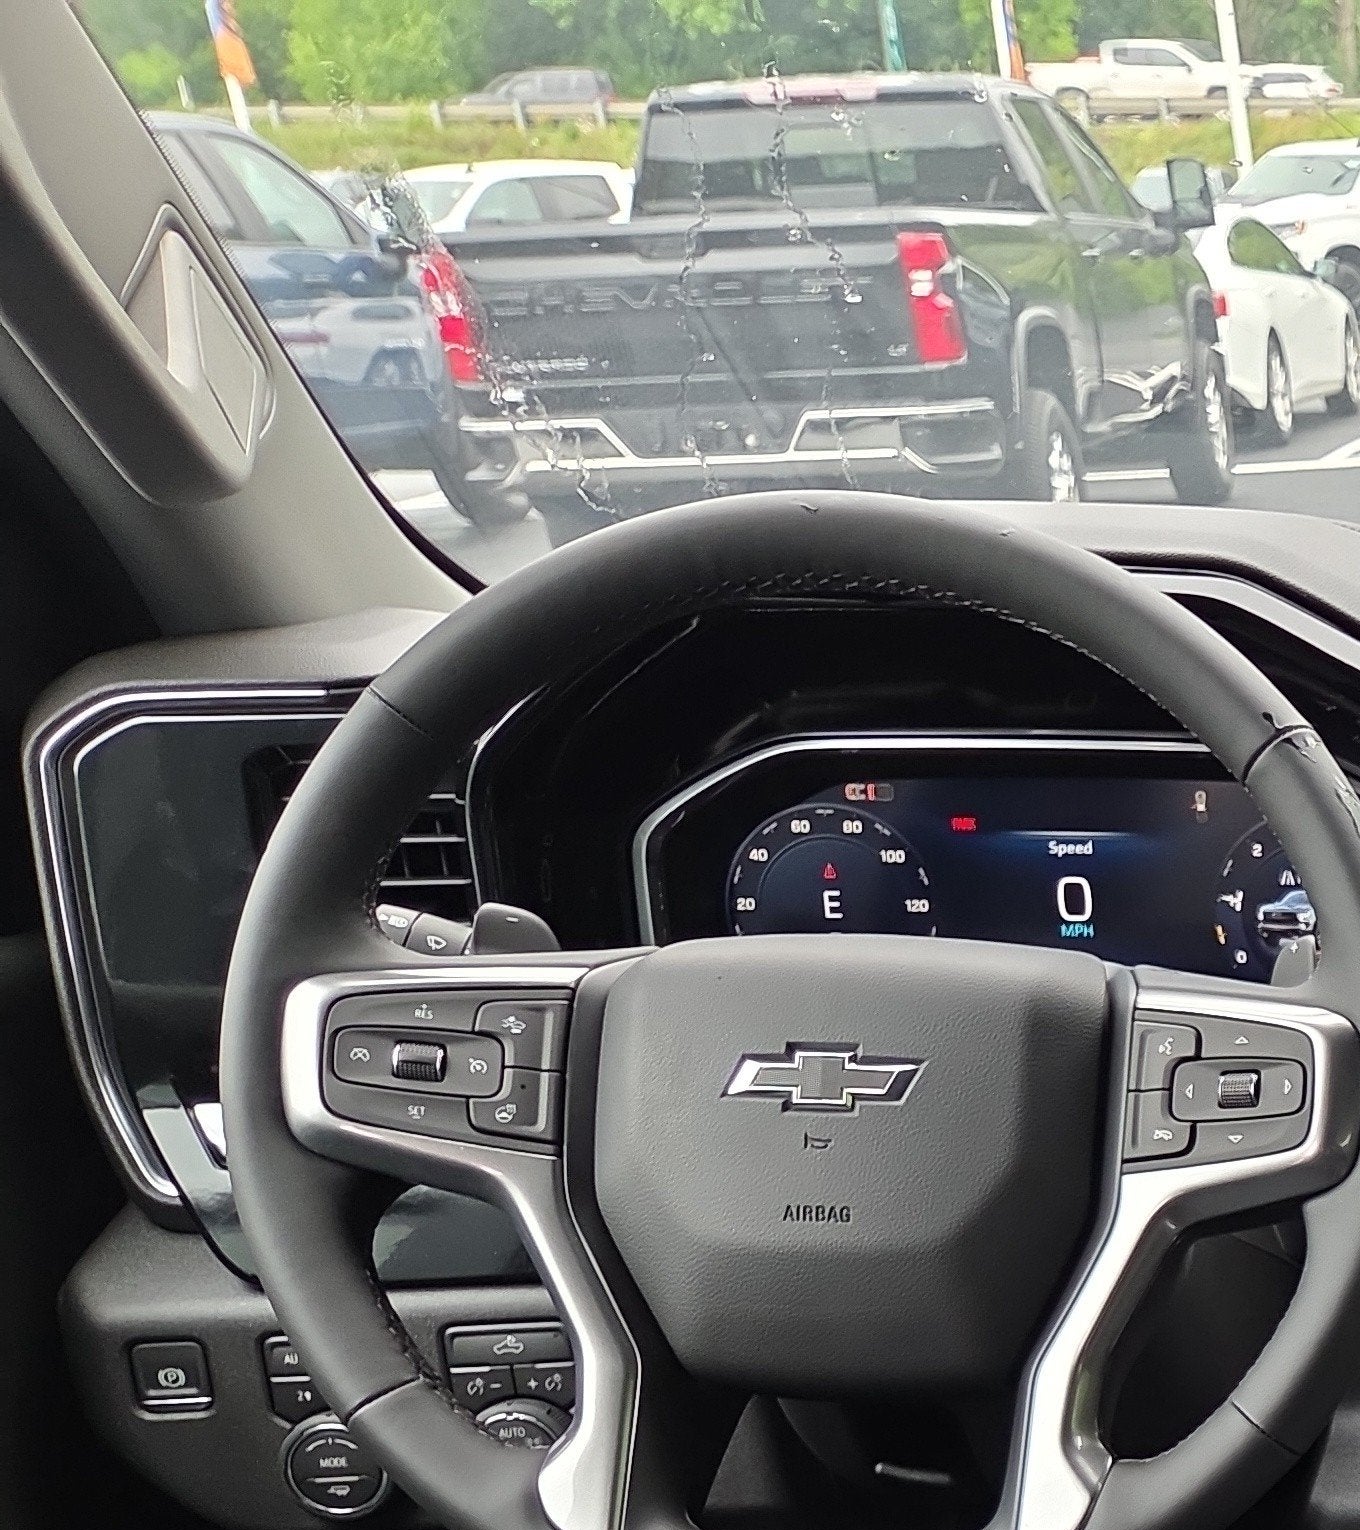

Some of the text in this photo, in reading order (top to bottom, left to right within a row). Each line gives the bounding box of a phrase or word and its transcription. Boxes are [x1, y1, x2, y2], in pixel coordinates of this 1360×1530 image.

[790, 819, 810, 834] 60
[842, 819, 863, 834] 80
[749, 848, 768, 862] 40
[879, 849, 905, 863] 100
[1048, 839, 1093, 858] Speed
[1251, 843, 1263, 858] 2
[736, 897, 755, 911] 20
[822, 890, 844, 919] E
[904, 898, 929, 913] 120
[1056, 875, 1093, 922] 0
[1060, 923, 1094, 938] MPH
[1235, 950, 1247, 964] 0
[407, 1105, 425, 1116] SET
[783, 1204, 851, 1223] AIRBAG
[499, 1427, 526, 1440] AUTO
[319, 1456, 348, 1468] MODE
